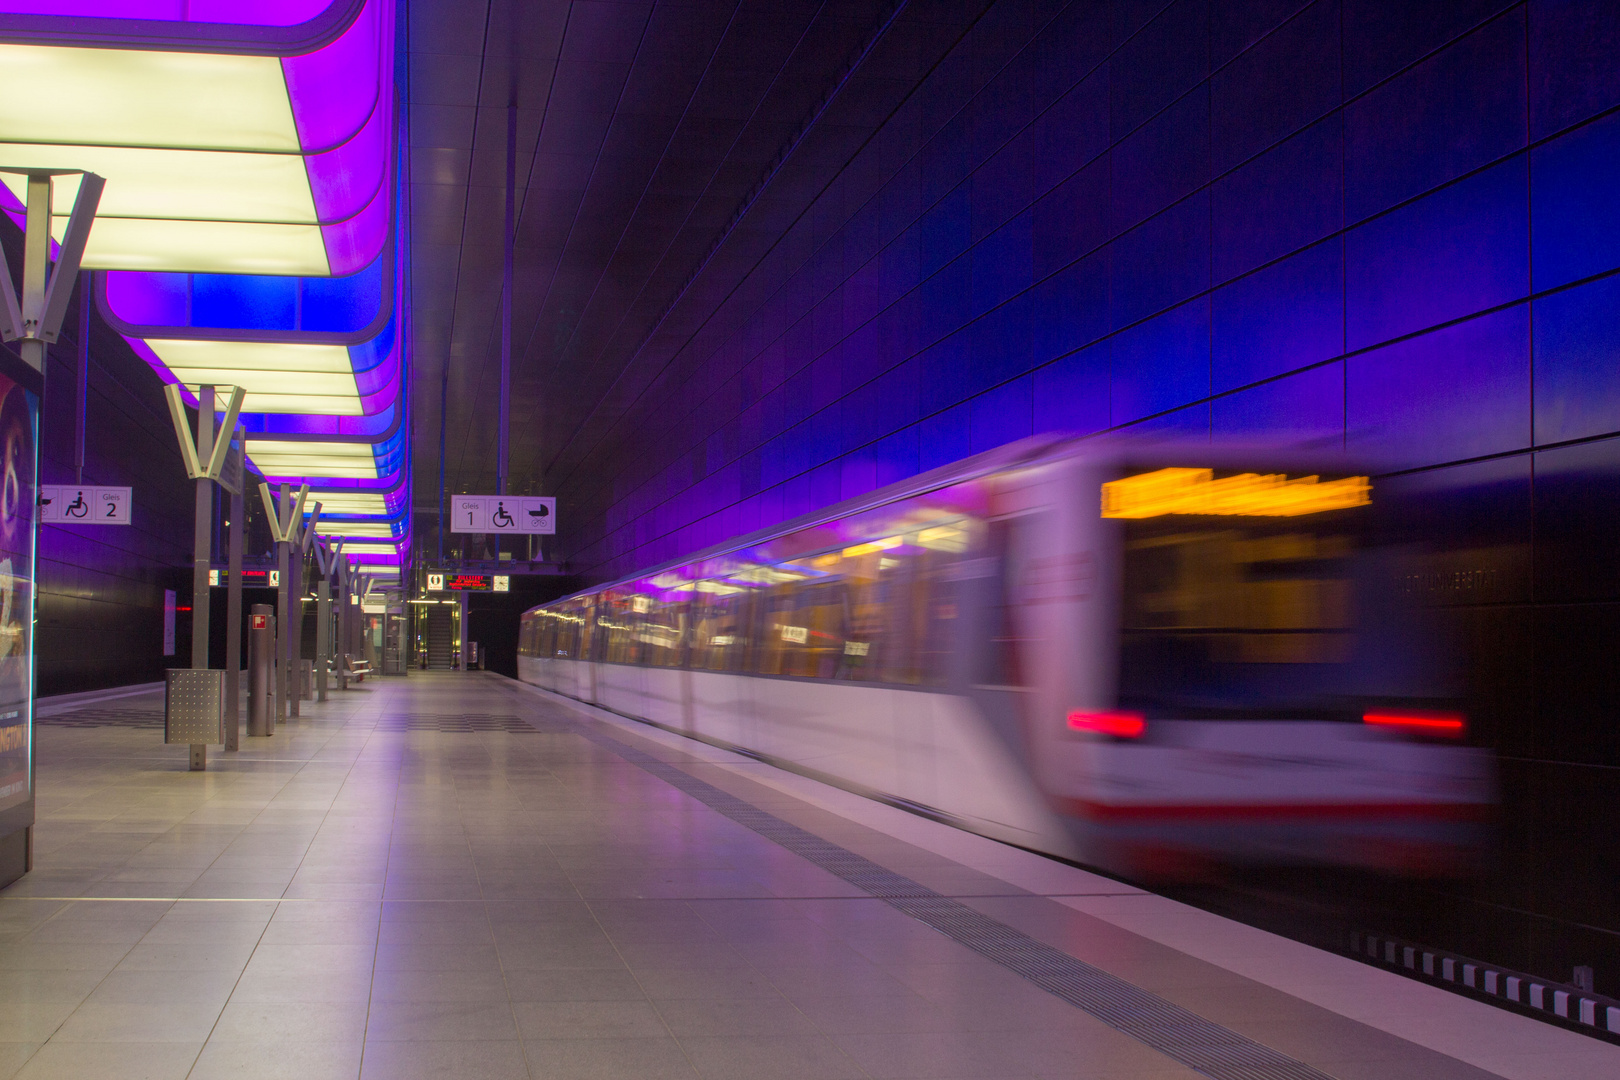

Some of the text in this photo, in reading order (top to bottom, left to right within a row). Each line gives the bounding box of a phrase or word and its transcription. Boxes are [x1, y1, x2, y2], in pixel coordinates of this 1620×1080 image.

[103, 493, 120, 501] Gleis
[106, 502, 116, 517] 2
[462, 502, 479, 510] Gleis
[467, 511, 473, 526] 1
